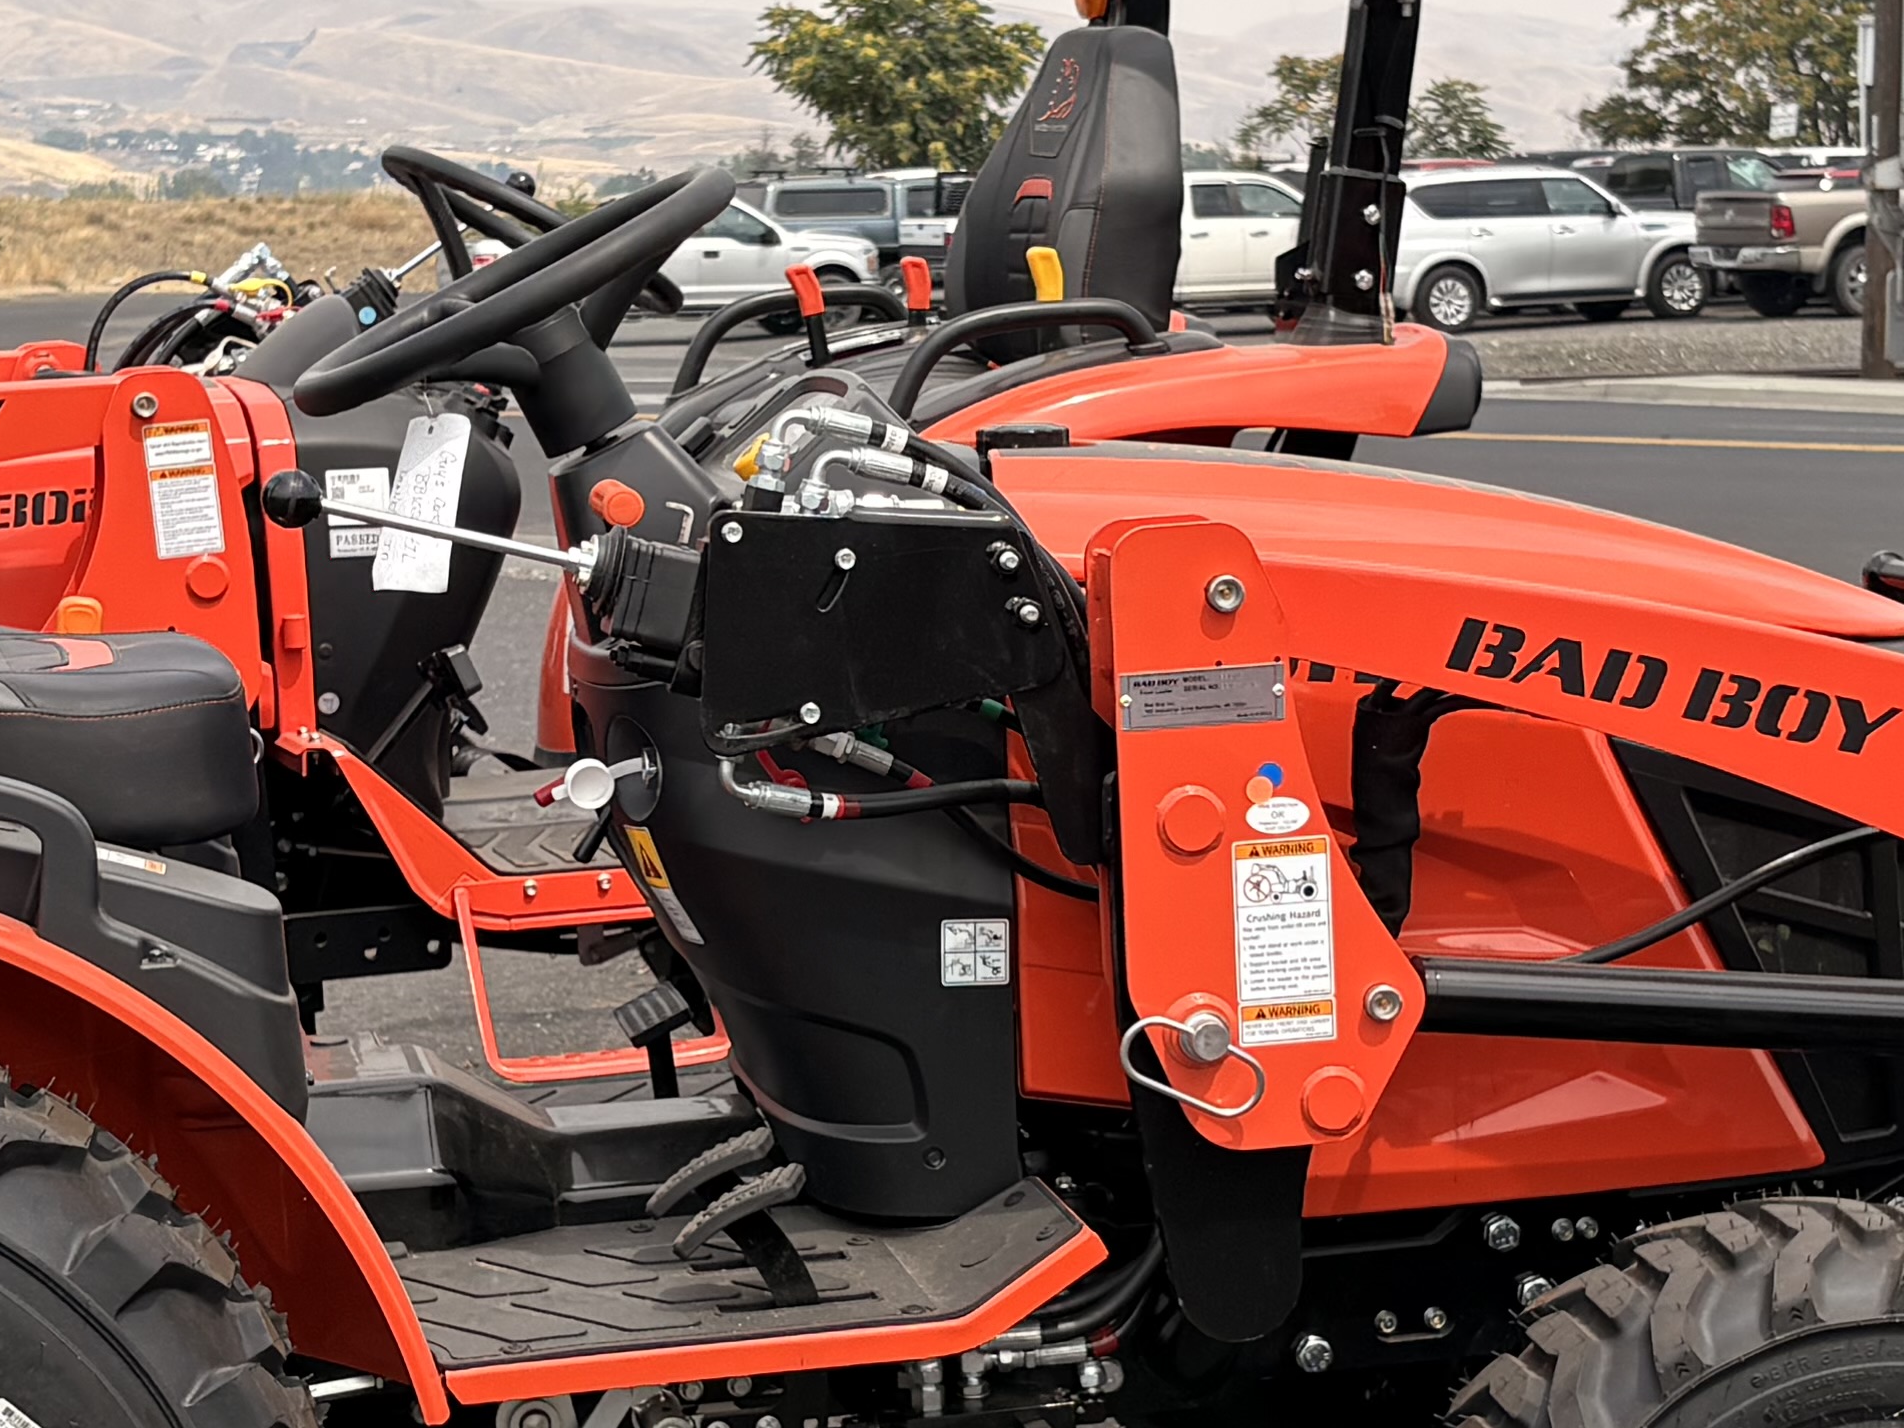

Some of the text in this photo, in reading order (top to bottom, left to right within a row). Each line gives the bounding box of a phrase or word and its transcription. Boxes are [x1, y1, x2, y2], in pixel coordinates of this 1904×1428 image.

[1445, 616, 1904, 756] BAD BOY
[1262, 842, 1314, 856] WARNING
[1246, 908, 1321, 923] Crushing Hazard
[1268, 1004, 1320, 1018] WARNING
